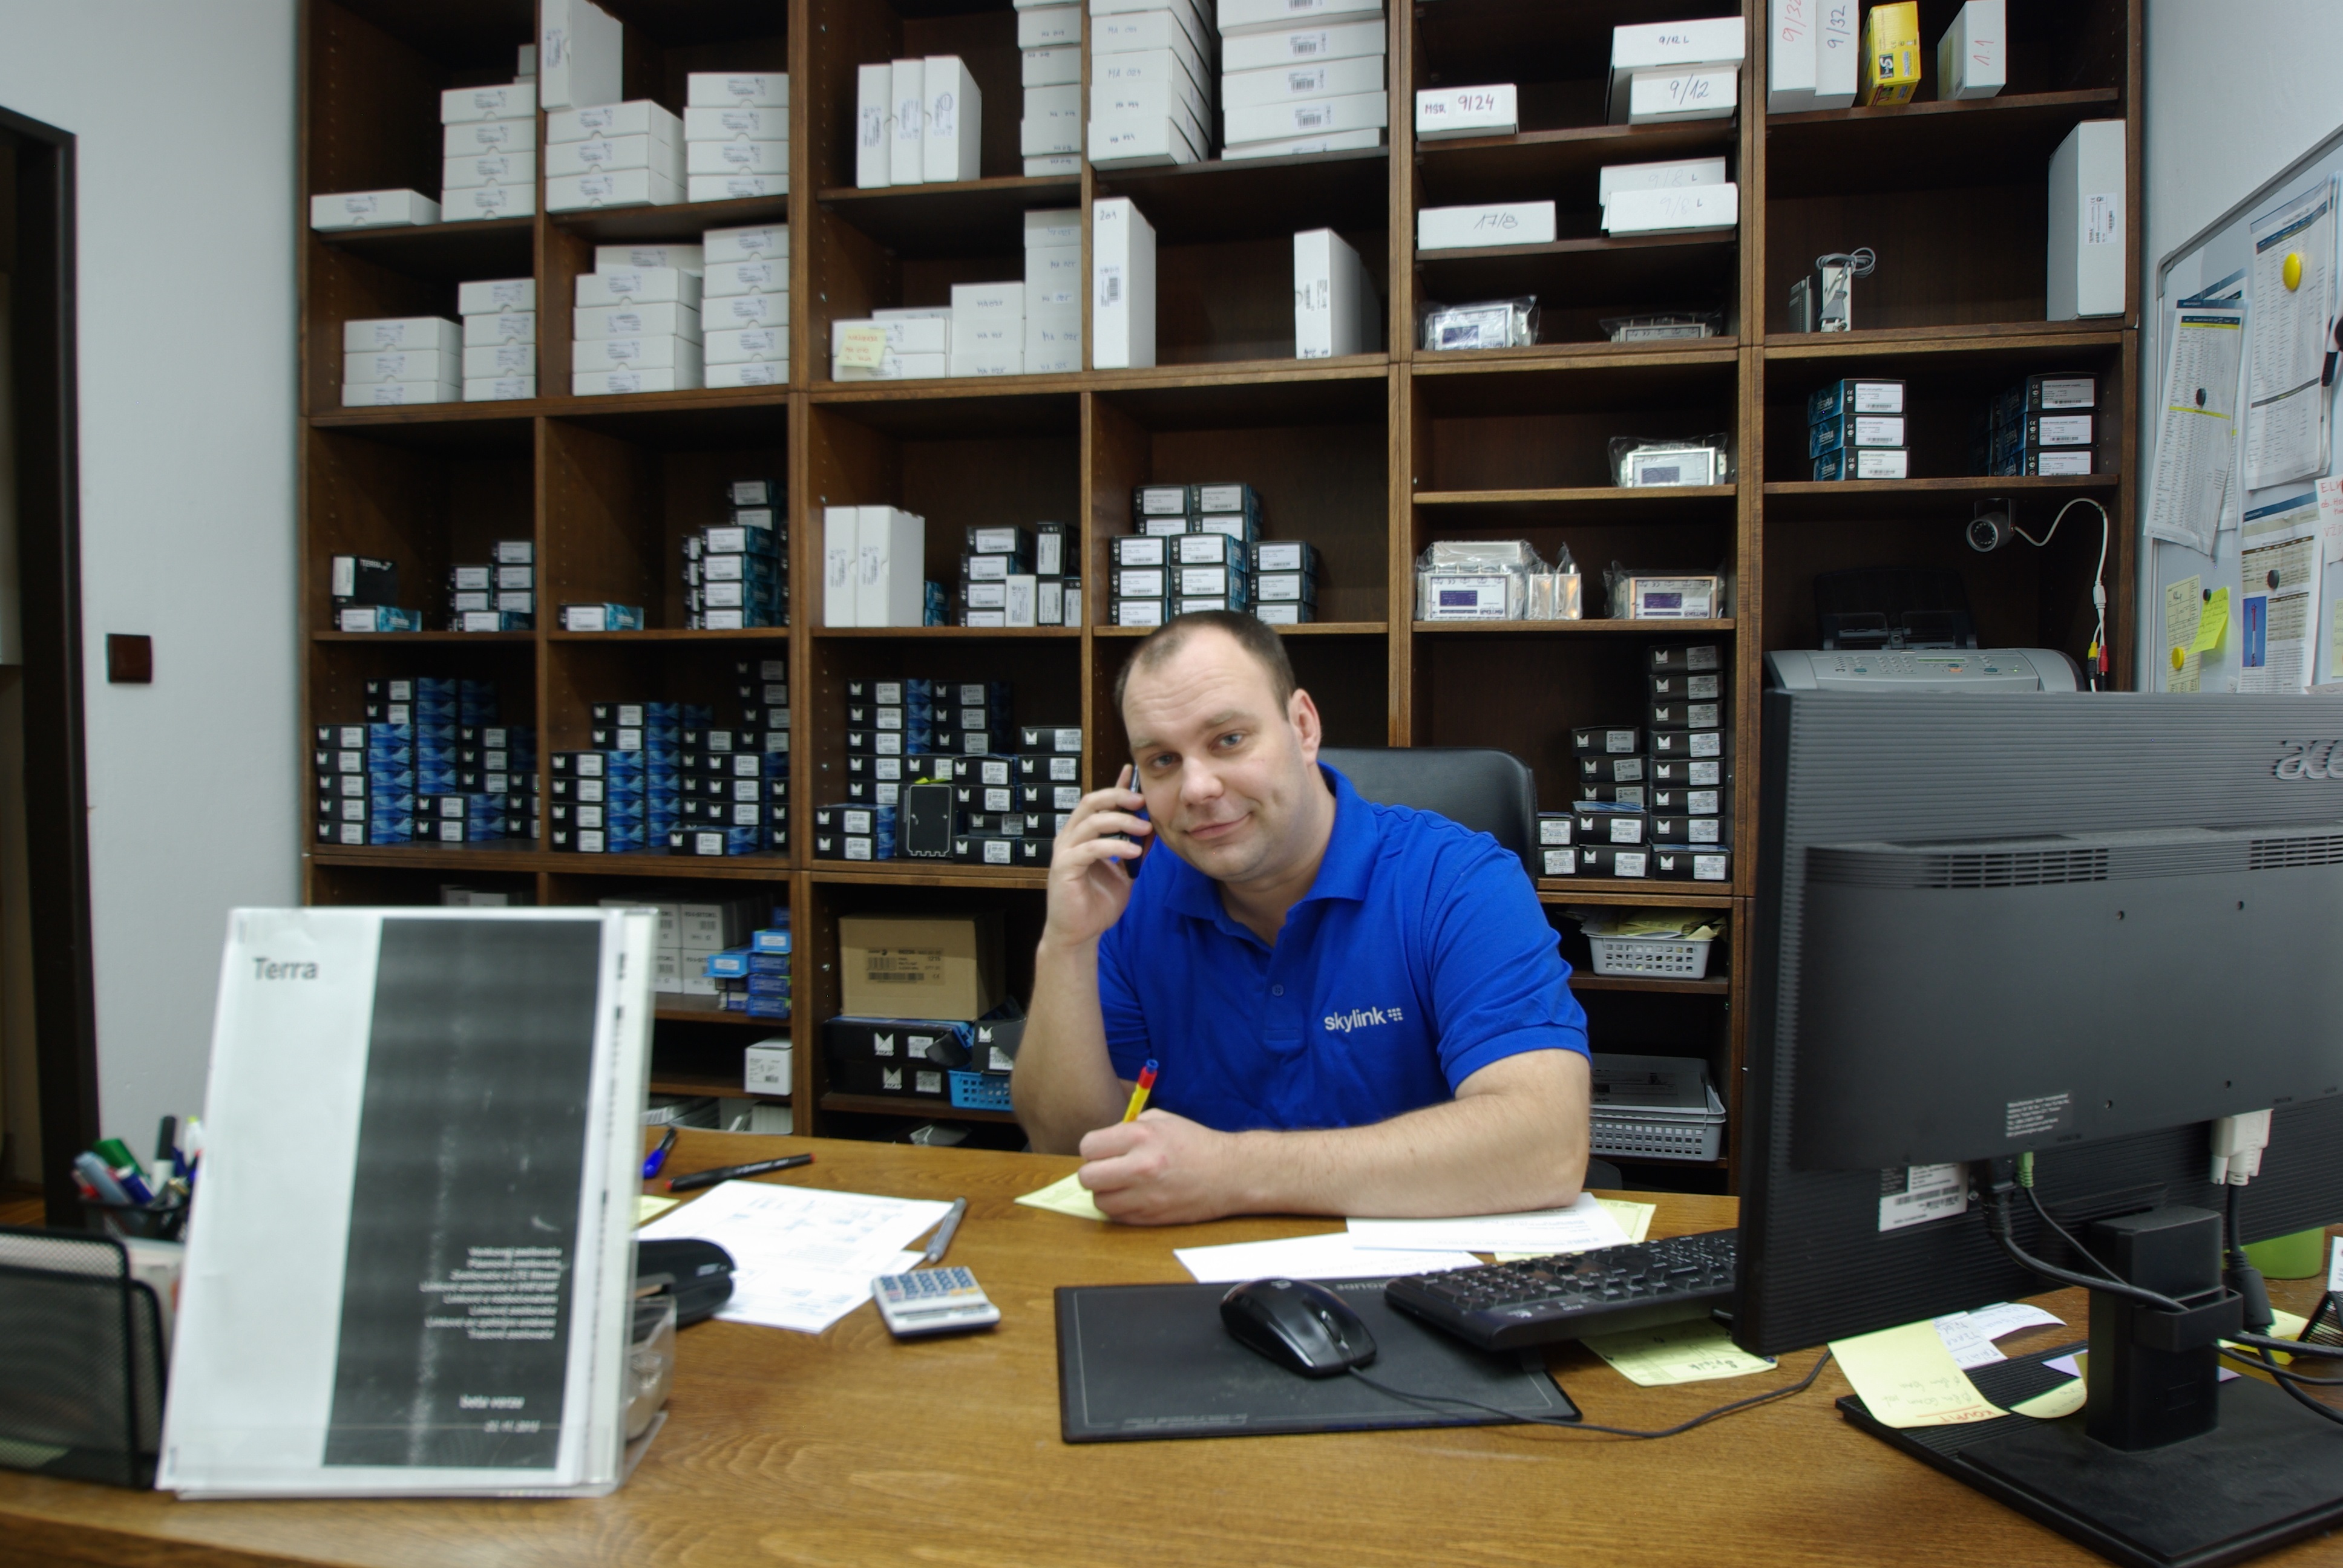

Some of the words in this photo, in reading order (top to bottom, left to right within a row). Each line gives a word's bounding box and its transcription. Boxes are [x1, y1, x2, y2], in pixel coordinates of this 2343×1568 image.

[1826, 5, 1850, 49] 9/32
[1670, 73, 1709, 106] 9/12
[252, 957, 320, 981] Terra
[1324, 1007, 1388, 1033] skylink
